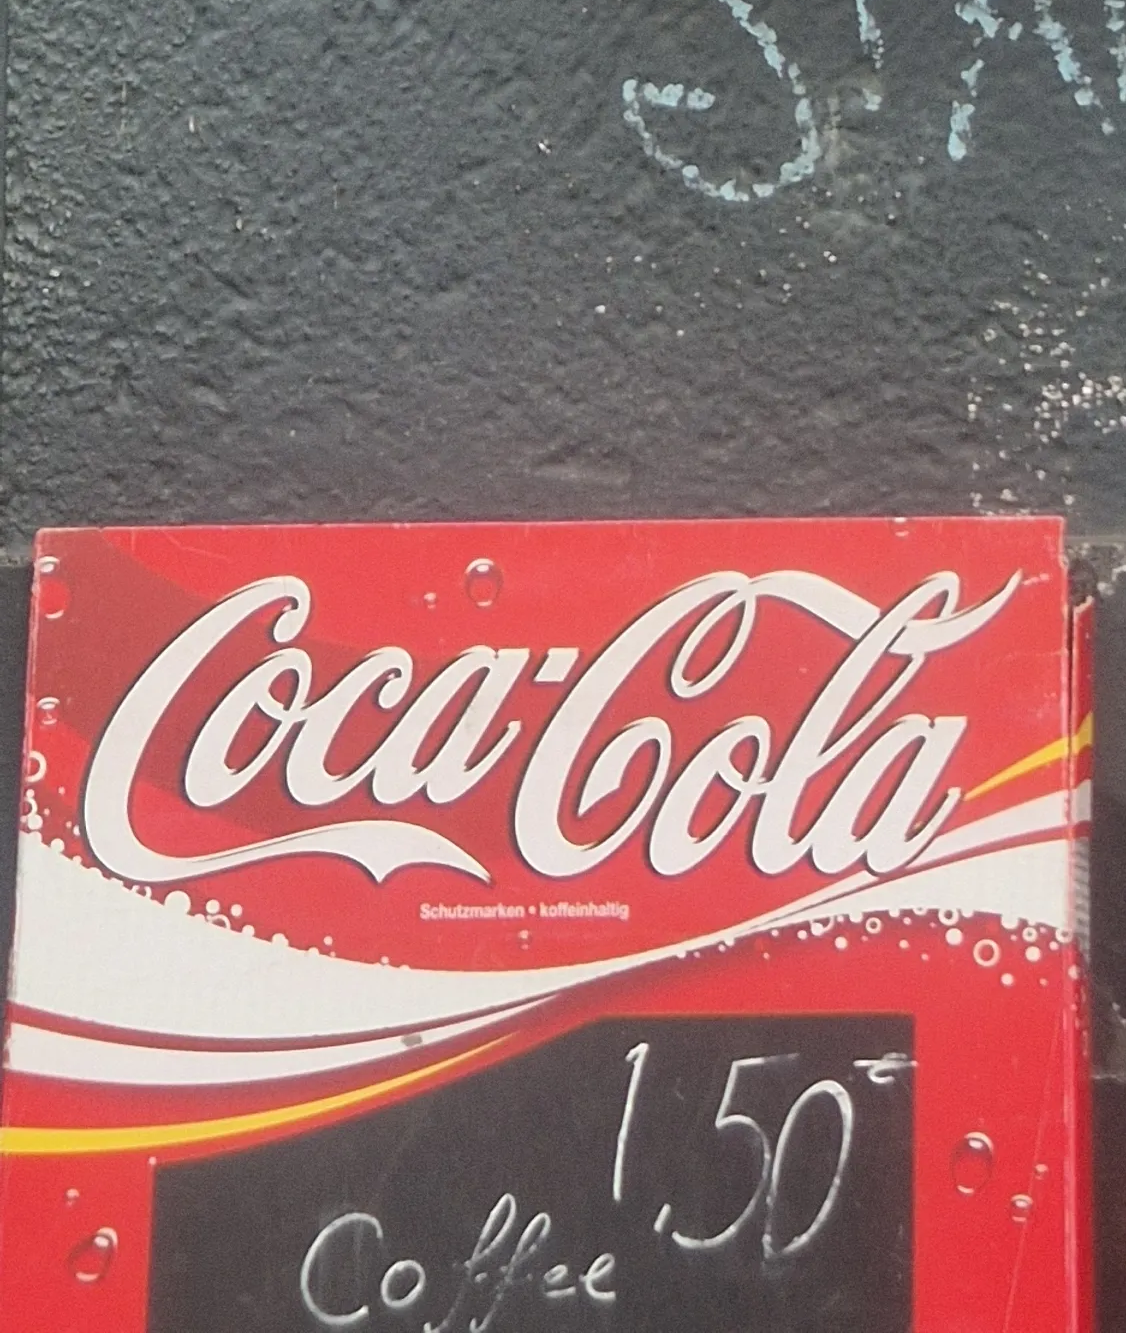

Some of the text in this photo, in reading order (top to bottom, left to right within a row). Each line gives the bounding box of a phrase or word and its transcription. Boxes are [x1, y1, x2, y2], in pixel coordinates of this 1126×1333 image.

[84, 567, 1024, 884] Coca-Cola
[419, 901, 630, 921] Schutzmarken koffeinhaltig
[300, 1192, 616, 1333] Coffee
